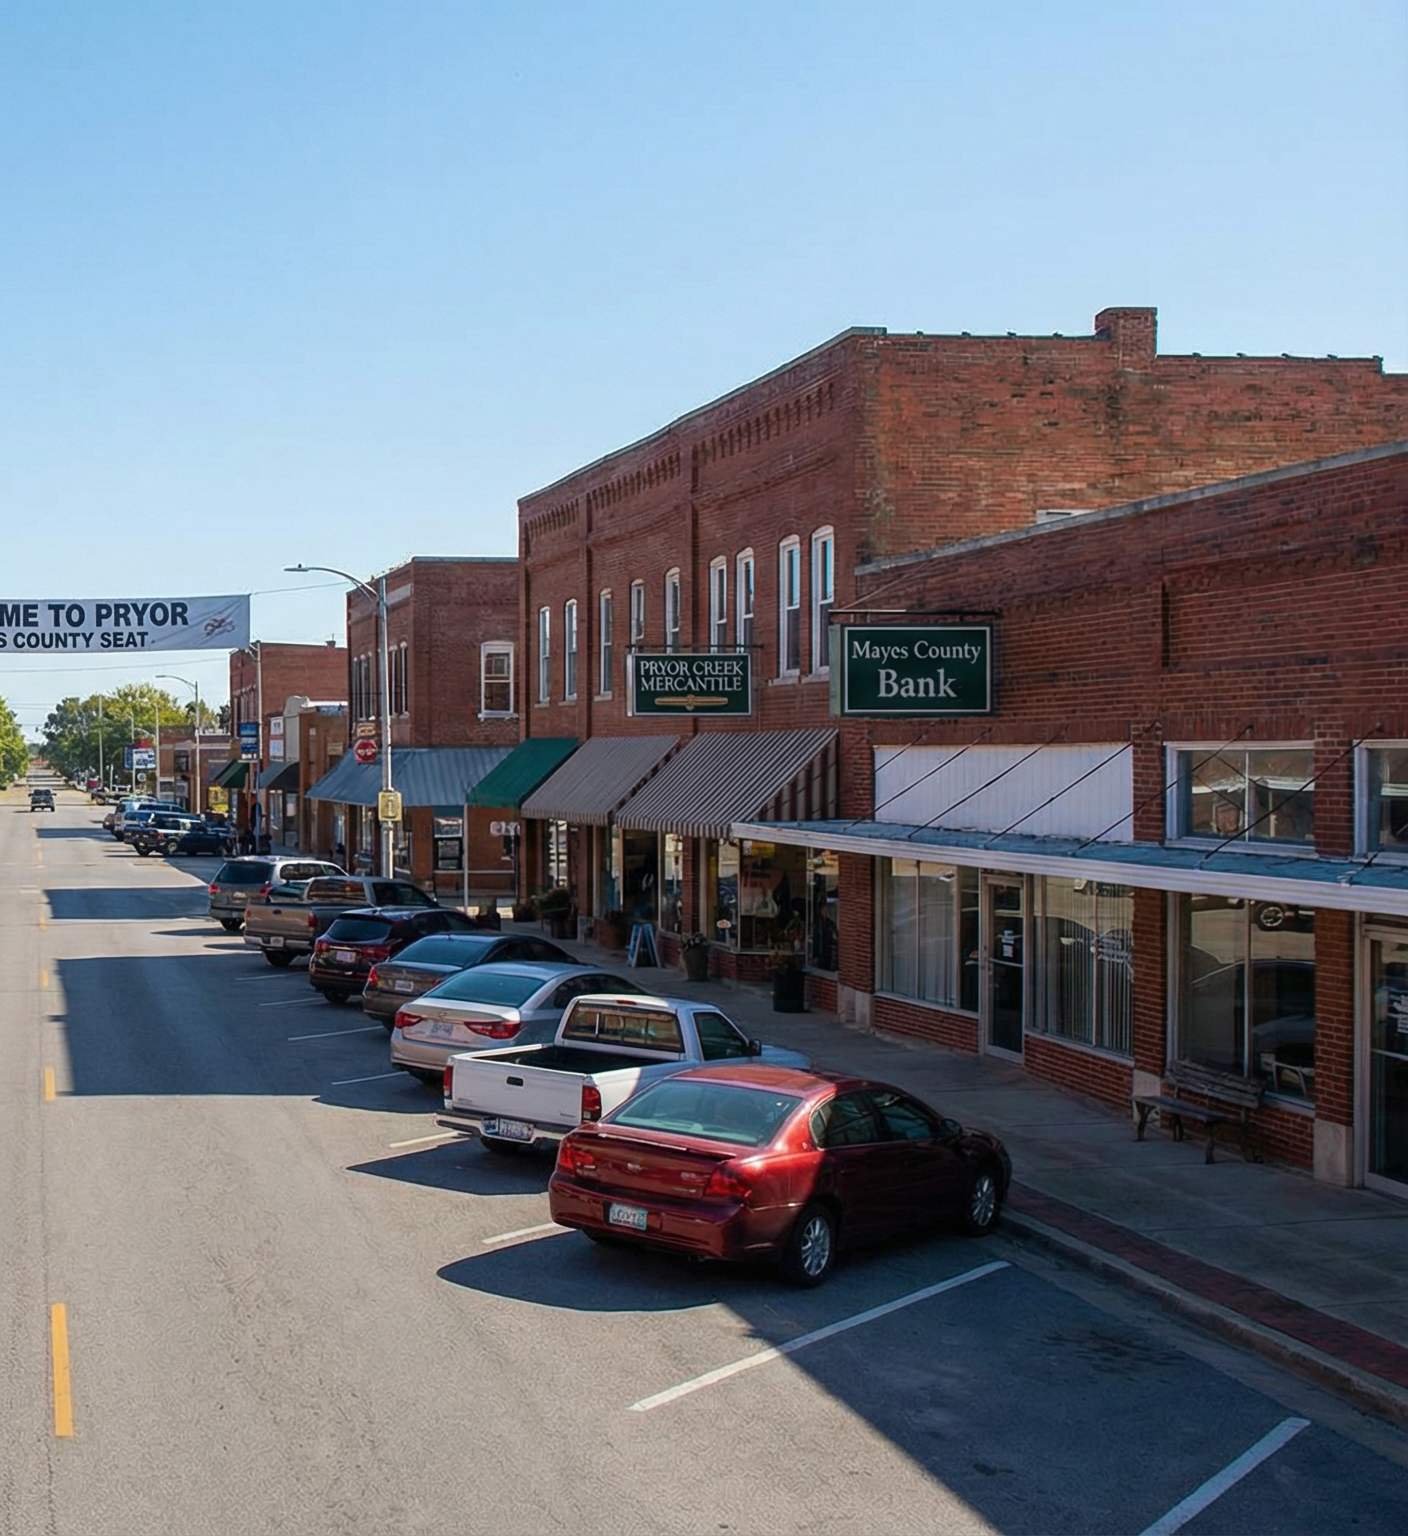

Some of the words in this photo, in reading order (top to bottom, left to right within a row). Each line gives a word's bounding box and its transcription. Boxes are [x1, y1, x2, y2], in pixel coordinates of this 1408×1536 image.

[48, 603, 85, 627] TO
[95, 602, 189, 627] PRYOR
[13, 632, 94, 648] COUNTY
[100, 631, 148, 648] SEAT
[852, 640, 909, 664] Mayes
[913, 640, 981, 664] County
[639, 660, 690, 676] PRYOR
[692, 660, 743, 676] CREEK
[640, 676, 742, 691] MERCANTILE
[877, 667, 957, 698] Bank
